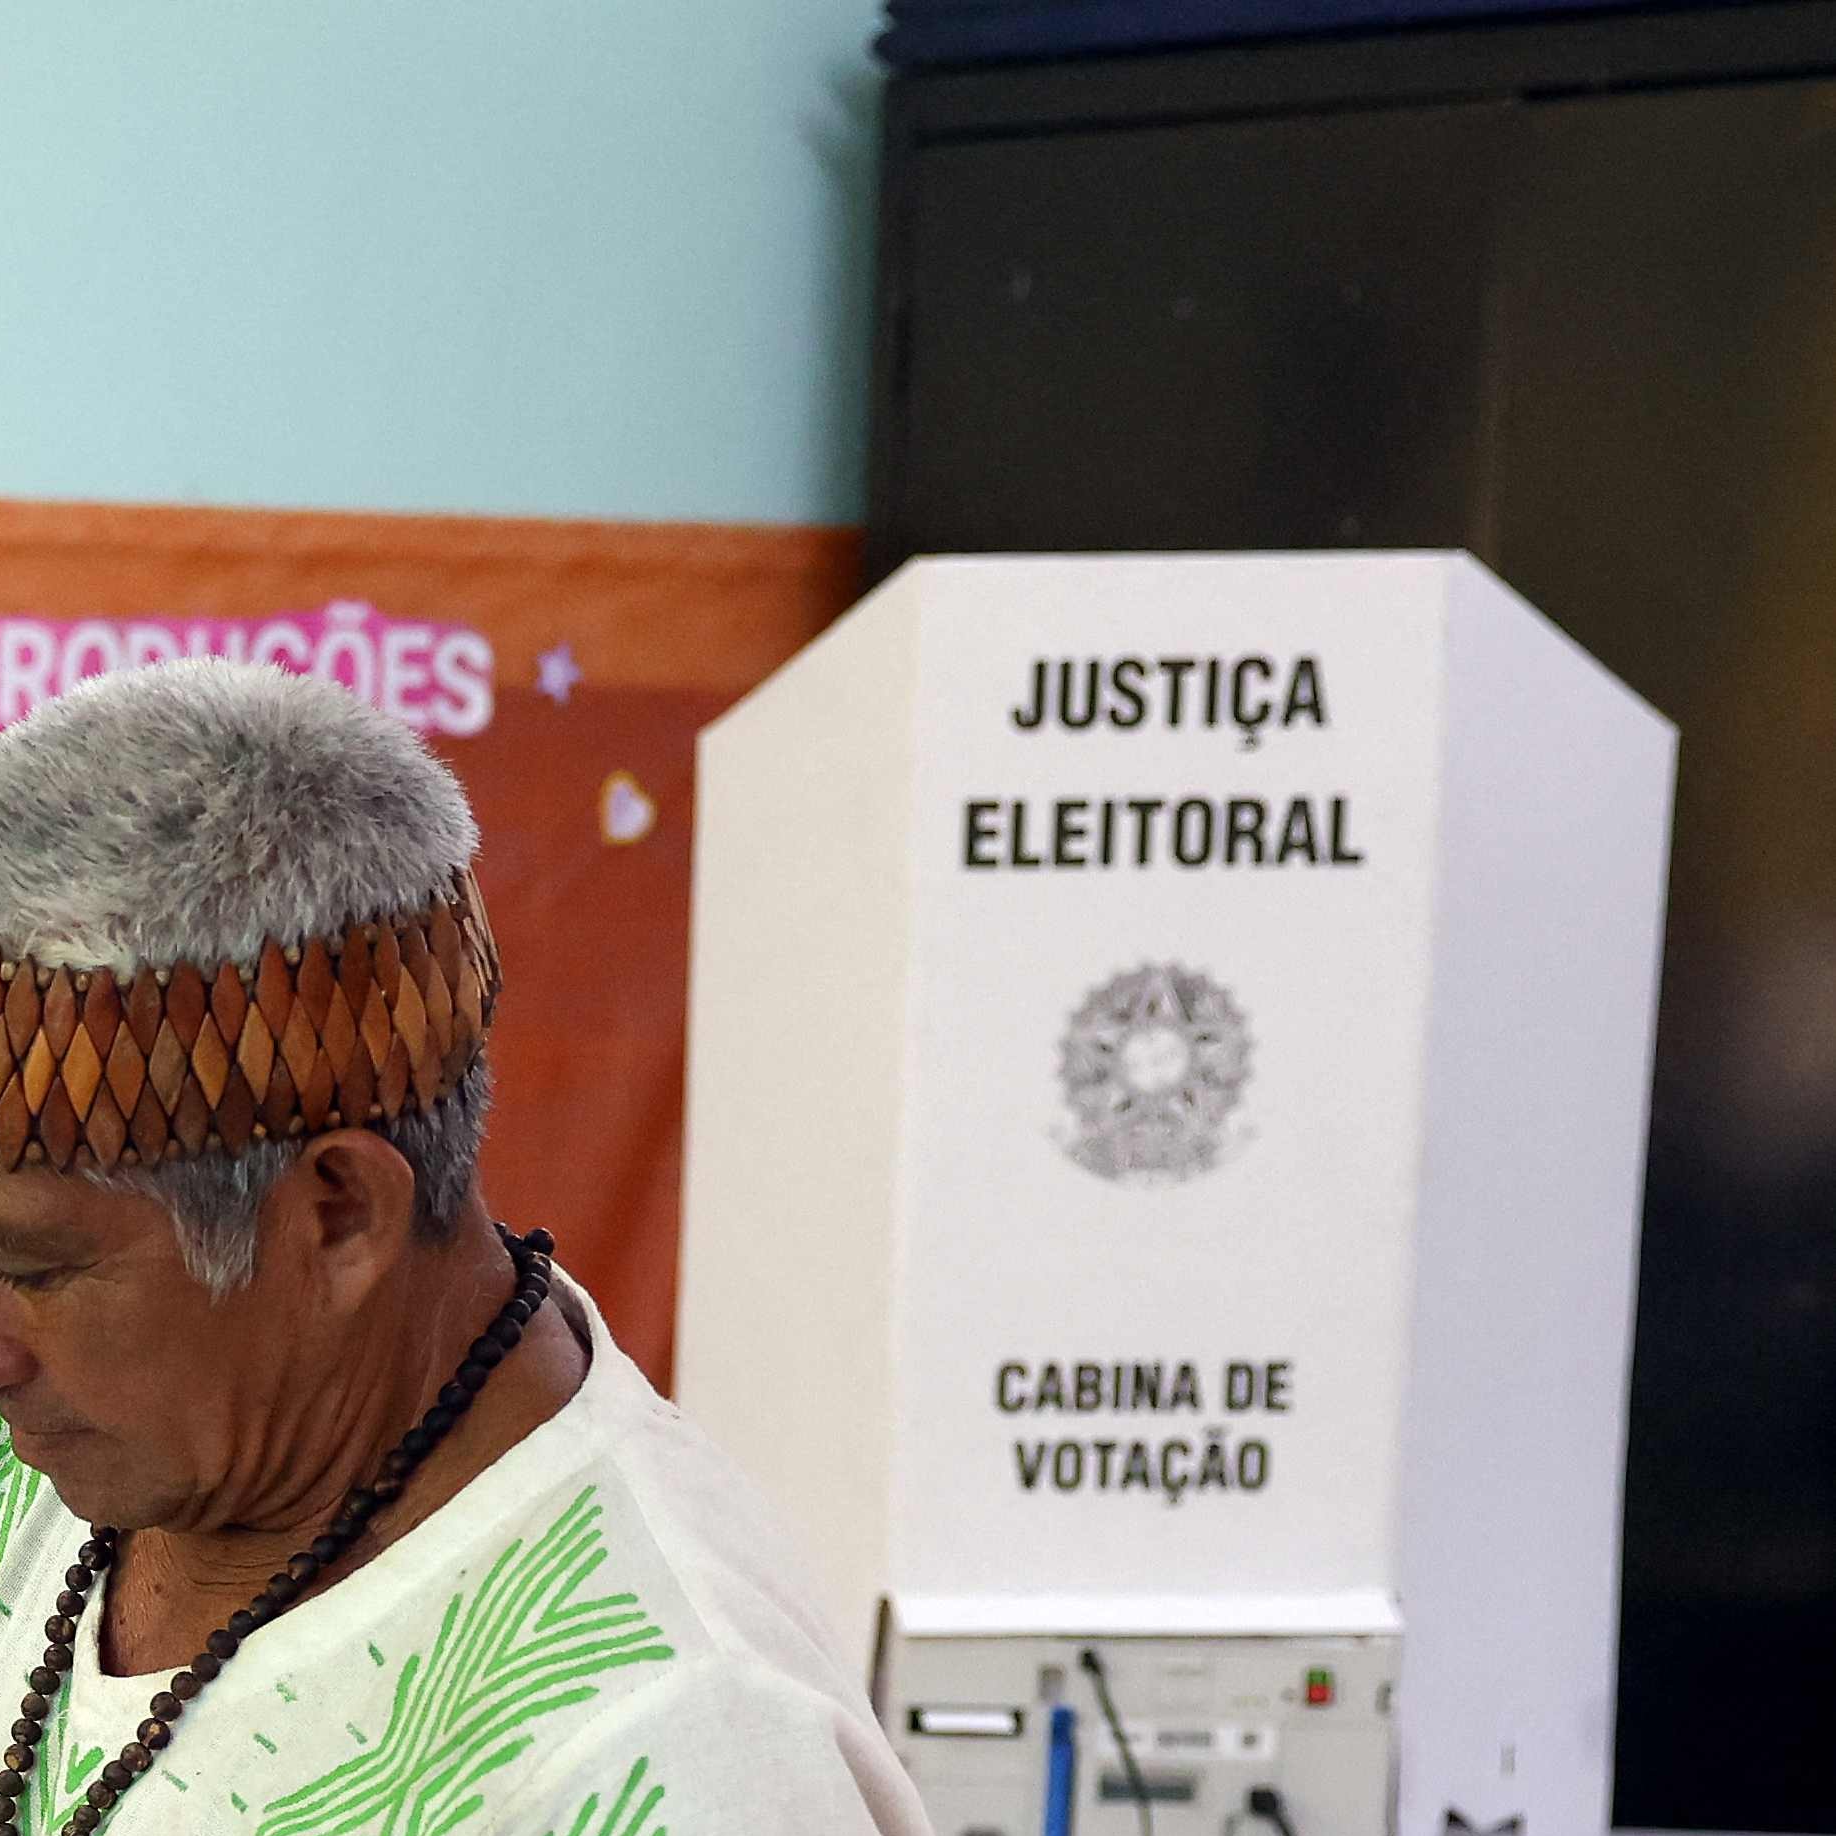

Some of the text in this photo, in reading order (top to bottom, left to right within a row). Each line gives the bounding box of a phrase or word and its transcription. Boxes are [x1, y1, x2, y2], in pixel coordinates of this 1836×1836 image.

[1011, 657, 1326, 751] JUSTIÇA
[963, 796, 1364, 869] ELEITORAL
[995, 1360, 1294, 1413] CABINA DE
[1015, 1427, 1271, 1504] VOTAÇÃO
